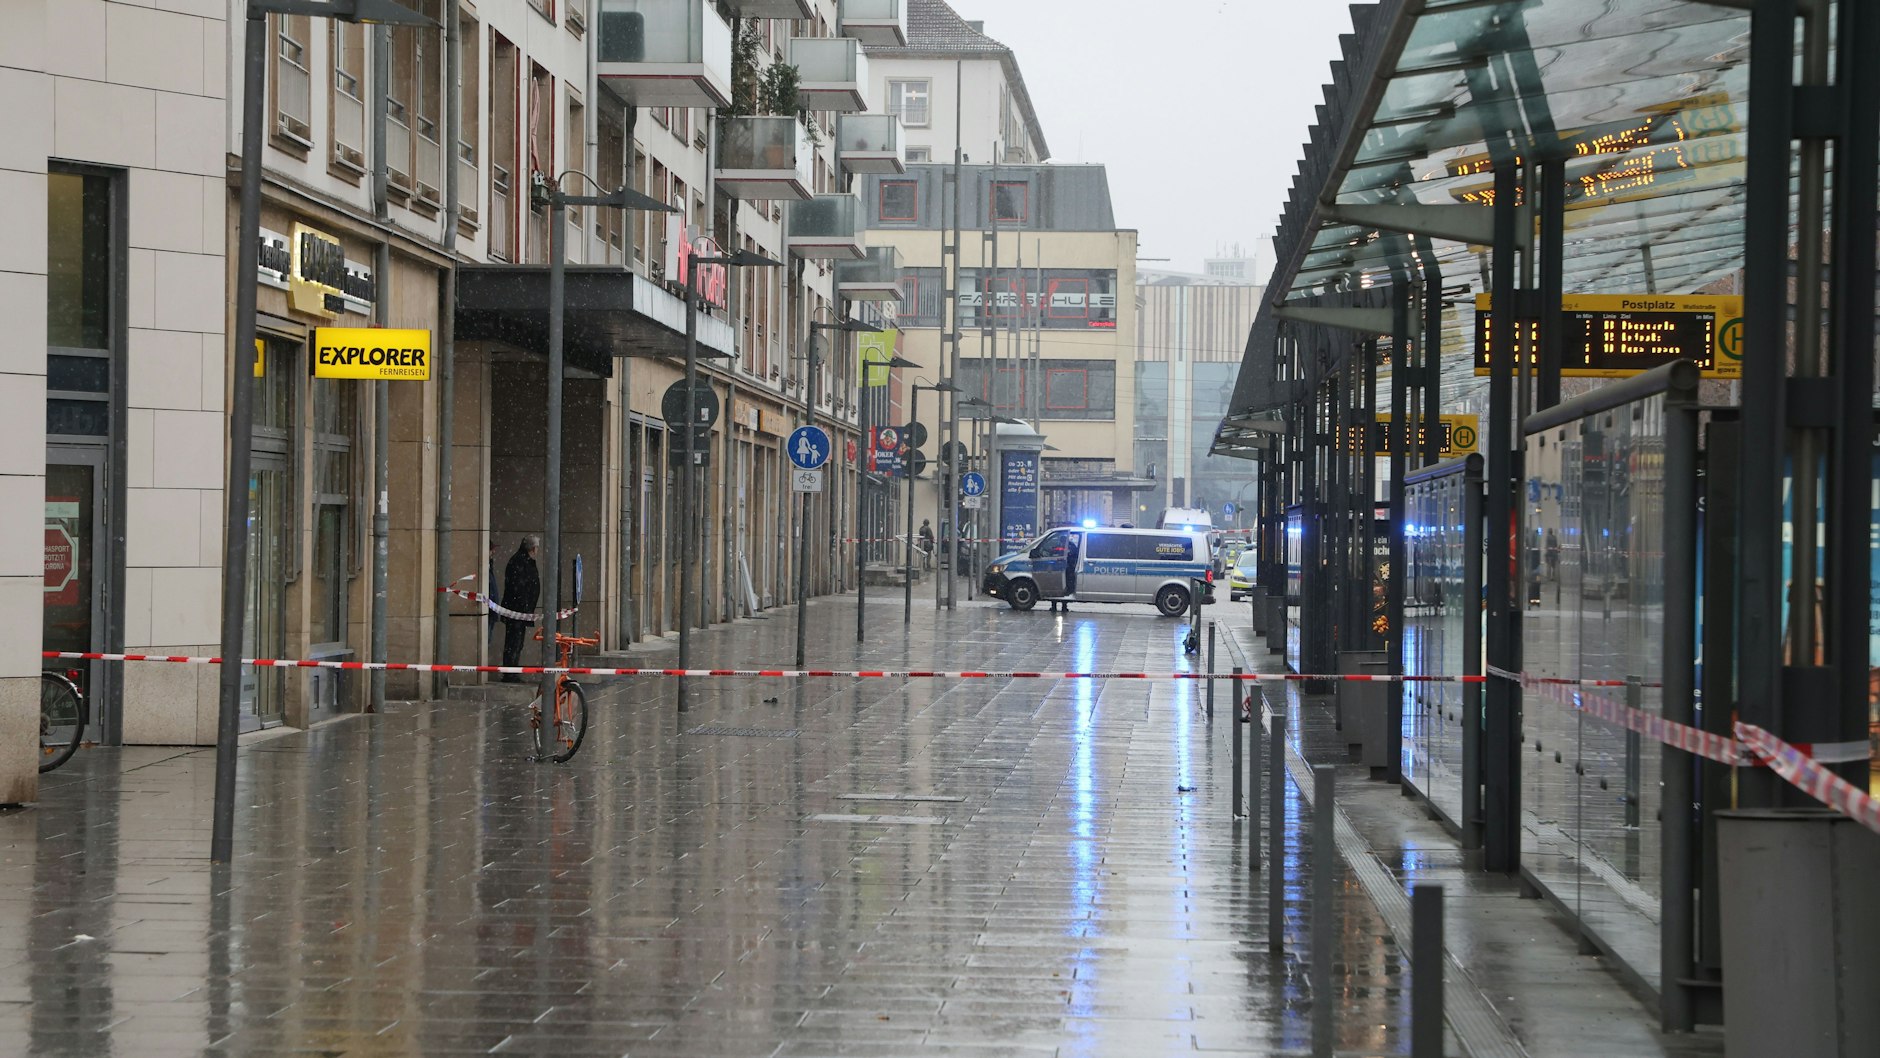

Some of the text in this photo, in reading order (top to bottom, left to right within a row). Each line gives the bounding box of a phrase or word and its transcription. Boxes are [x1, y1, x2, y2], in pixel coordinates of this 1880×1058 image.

[959, 294, 1115, 306] FAHRSHULE
[1622, 300, 1676, 311] Postplatz
[319, 346, 426, 367] EXPLORER
[379, 367, 426, 376] FERNREISEN
[873, 449, 894, 459] JOKER
[1093, 566, 1128, 575] POLIZEI
